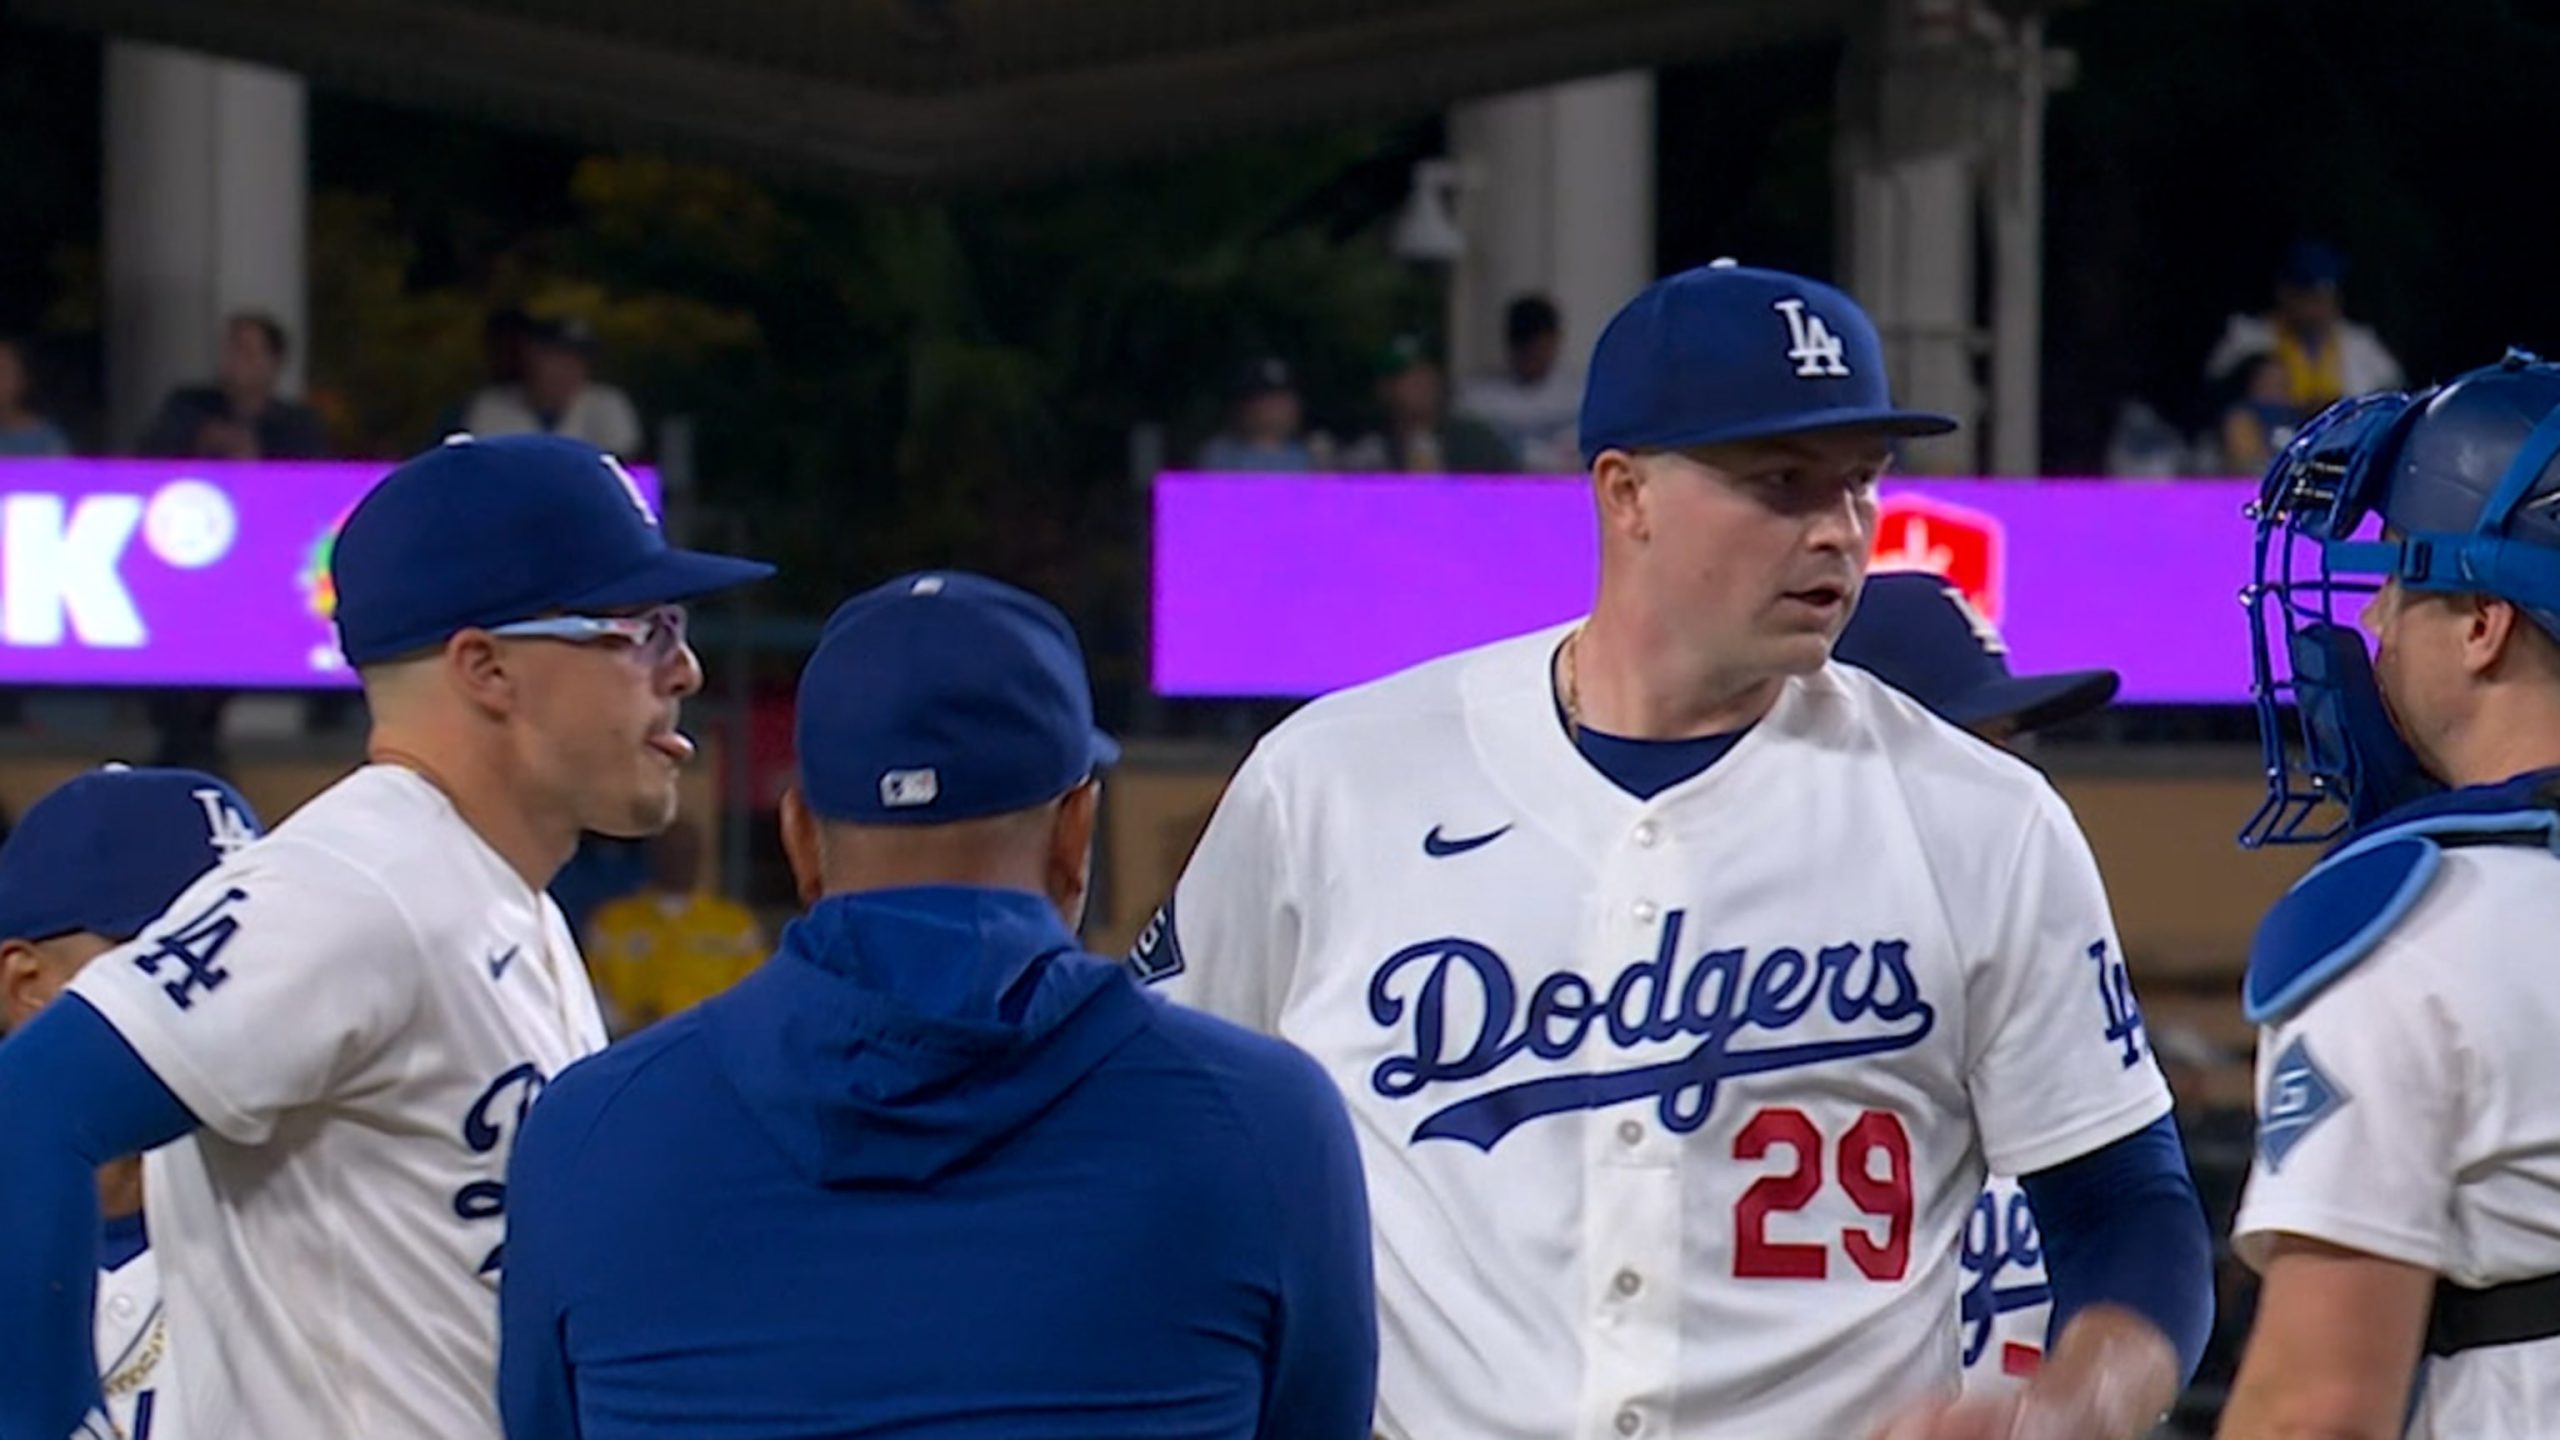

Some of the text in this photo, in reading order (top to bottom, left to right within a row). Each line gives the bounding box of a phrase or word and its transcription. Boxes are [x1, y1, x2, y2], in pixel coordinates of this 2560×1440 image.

[1773, 298, 1851, 377] LA
[134, 887, 247, 1010] LA
[1368, 910, 1935, 1134] Dodgers
[1731, 1107, 1915, 1283] 29
